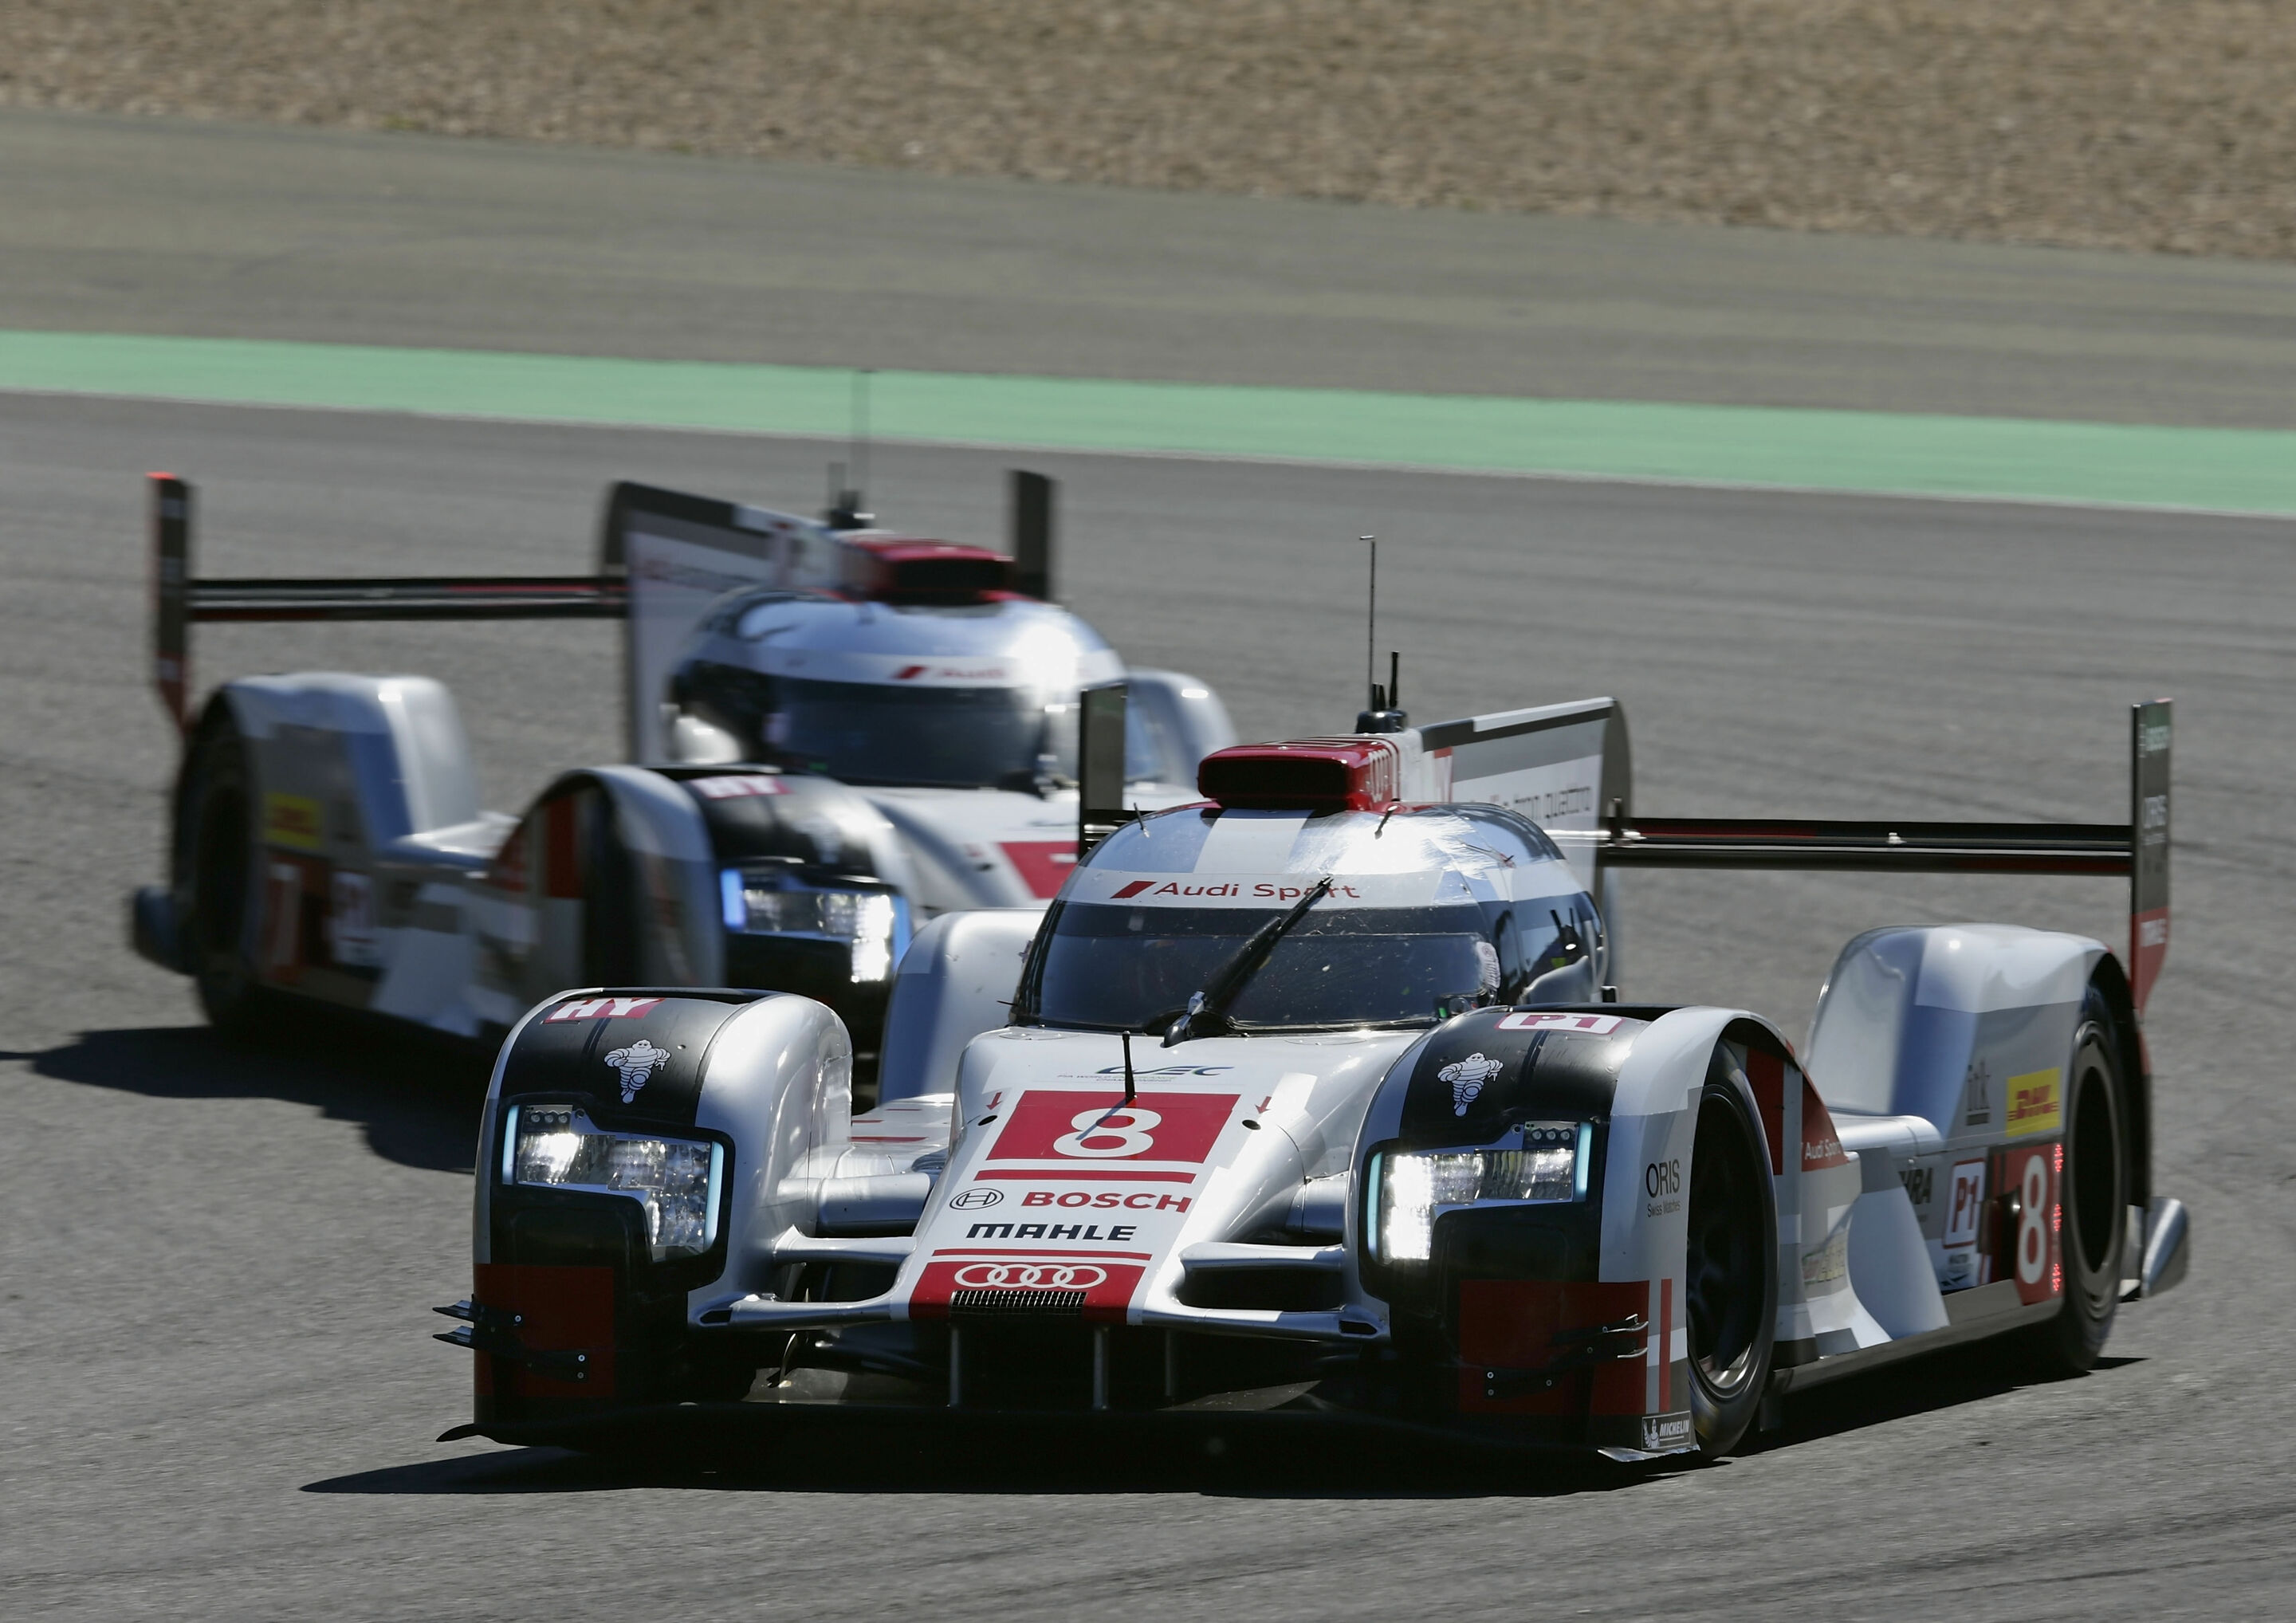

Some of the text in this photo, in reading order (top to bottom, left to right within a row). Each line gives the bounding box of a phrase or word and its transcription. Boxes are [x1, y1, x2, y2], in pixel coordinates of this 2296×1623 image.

[1153, 882, 1239, 897] Audi
[549, 998, 659, 1020] HY
[1519, 1014, 1602, 1028] P1
[1095, 1065, 1235, 1076] WEC
[1052, 1107, 1162, 1157] 8
[1804, 1140, 1824, 1160] Audi
[1645, 1158, 1681, 1198] ORIS
[1020, 1192, 1193, 1213] BOSCH
[1951, 1175, 1980, 1233] P1
[2018, 1154, 2047, 1284] 8
[965, 1223, 1138, 1241] MAHLE
[1659, 1419, 1690, 1437] MICHELIN
